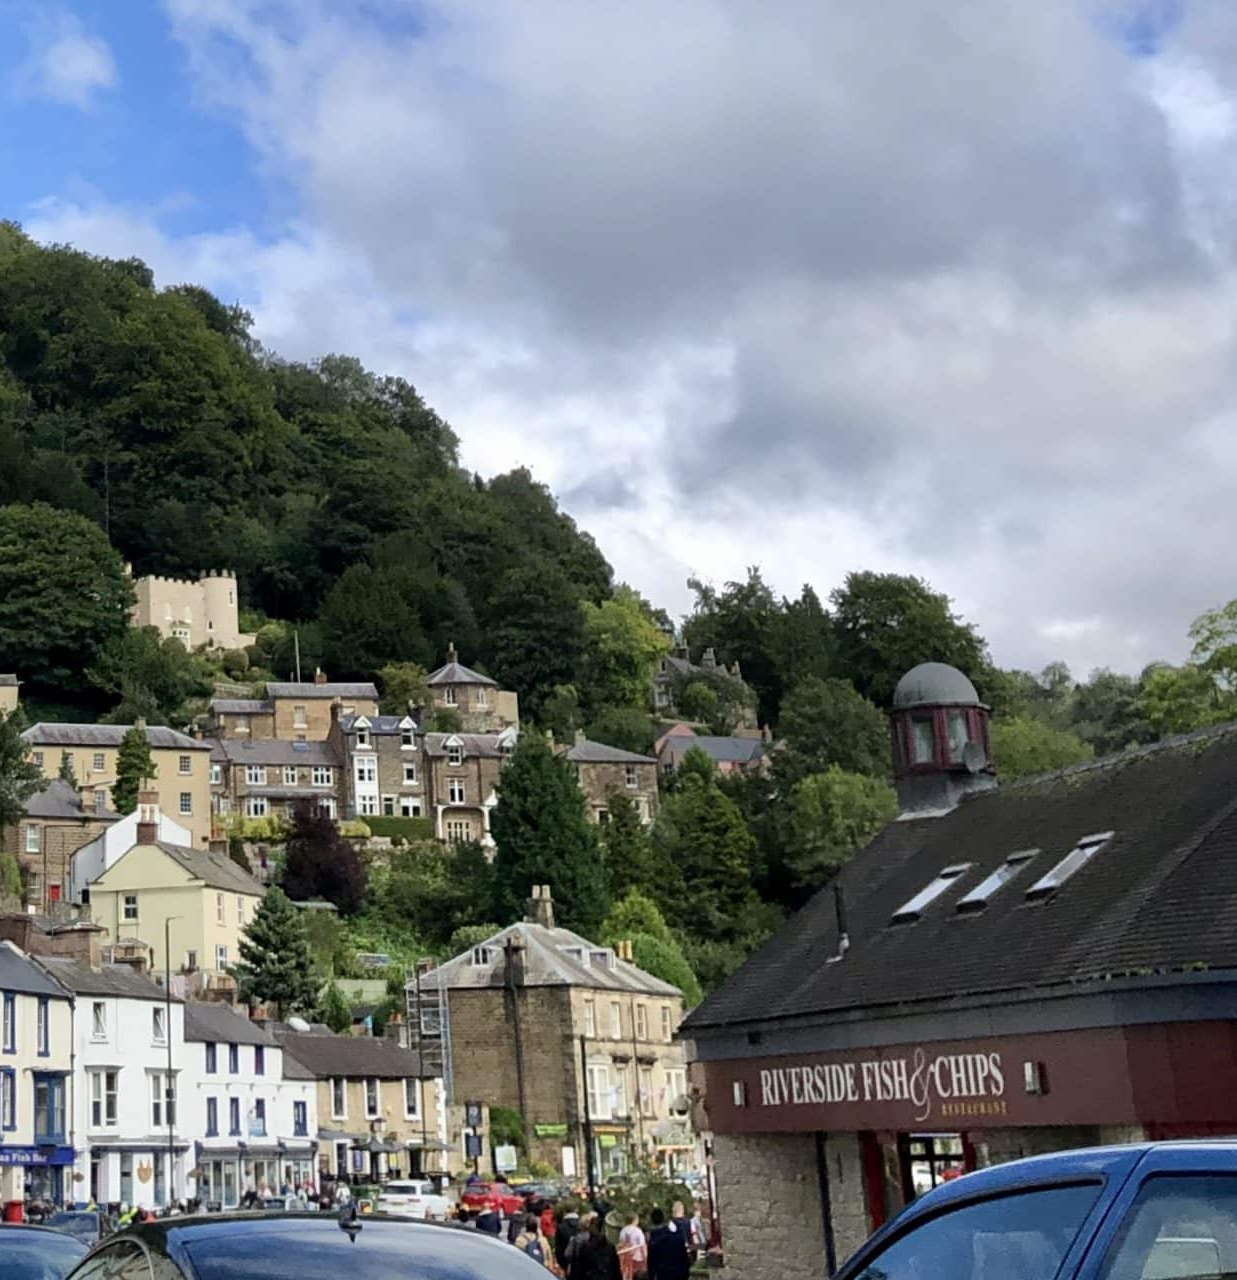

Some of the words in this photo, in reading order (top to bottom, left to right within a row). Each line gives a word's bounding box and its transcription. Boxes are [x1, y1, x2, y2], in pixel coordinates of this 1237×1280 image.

[760, 1063, 859, 1106] RIVERSIDE
[860, 1059, 910, 1100] FISH
[910, 1047, 935, 1121] &
[934, 1052, 1005, 1097] CHIPS
